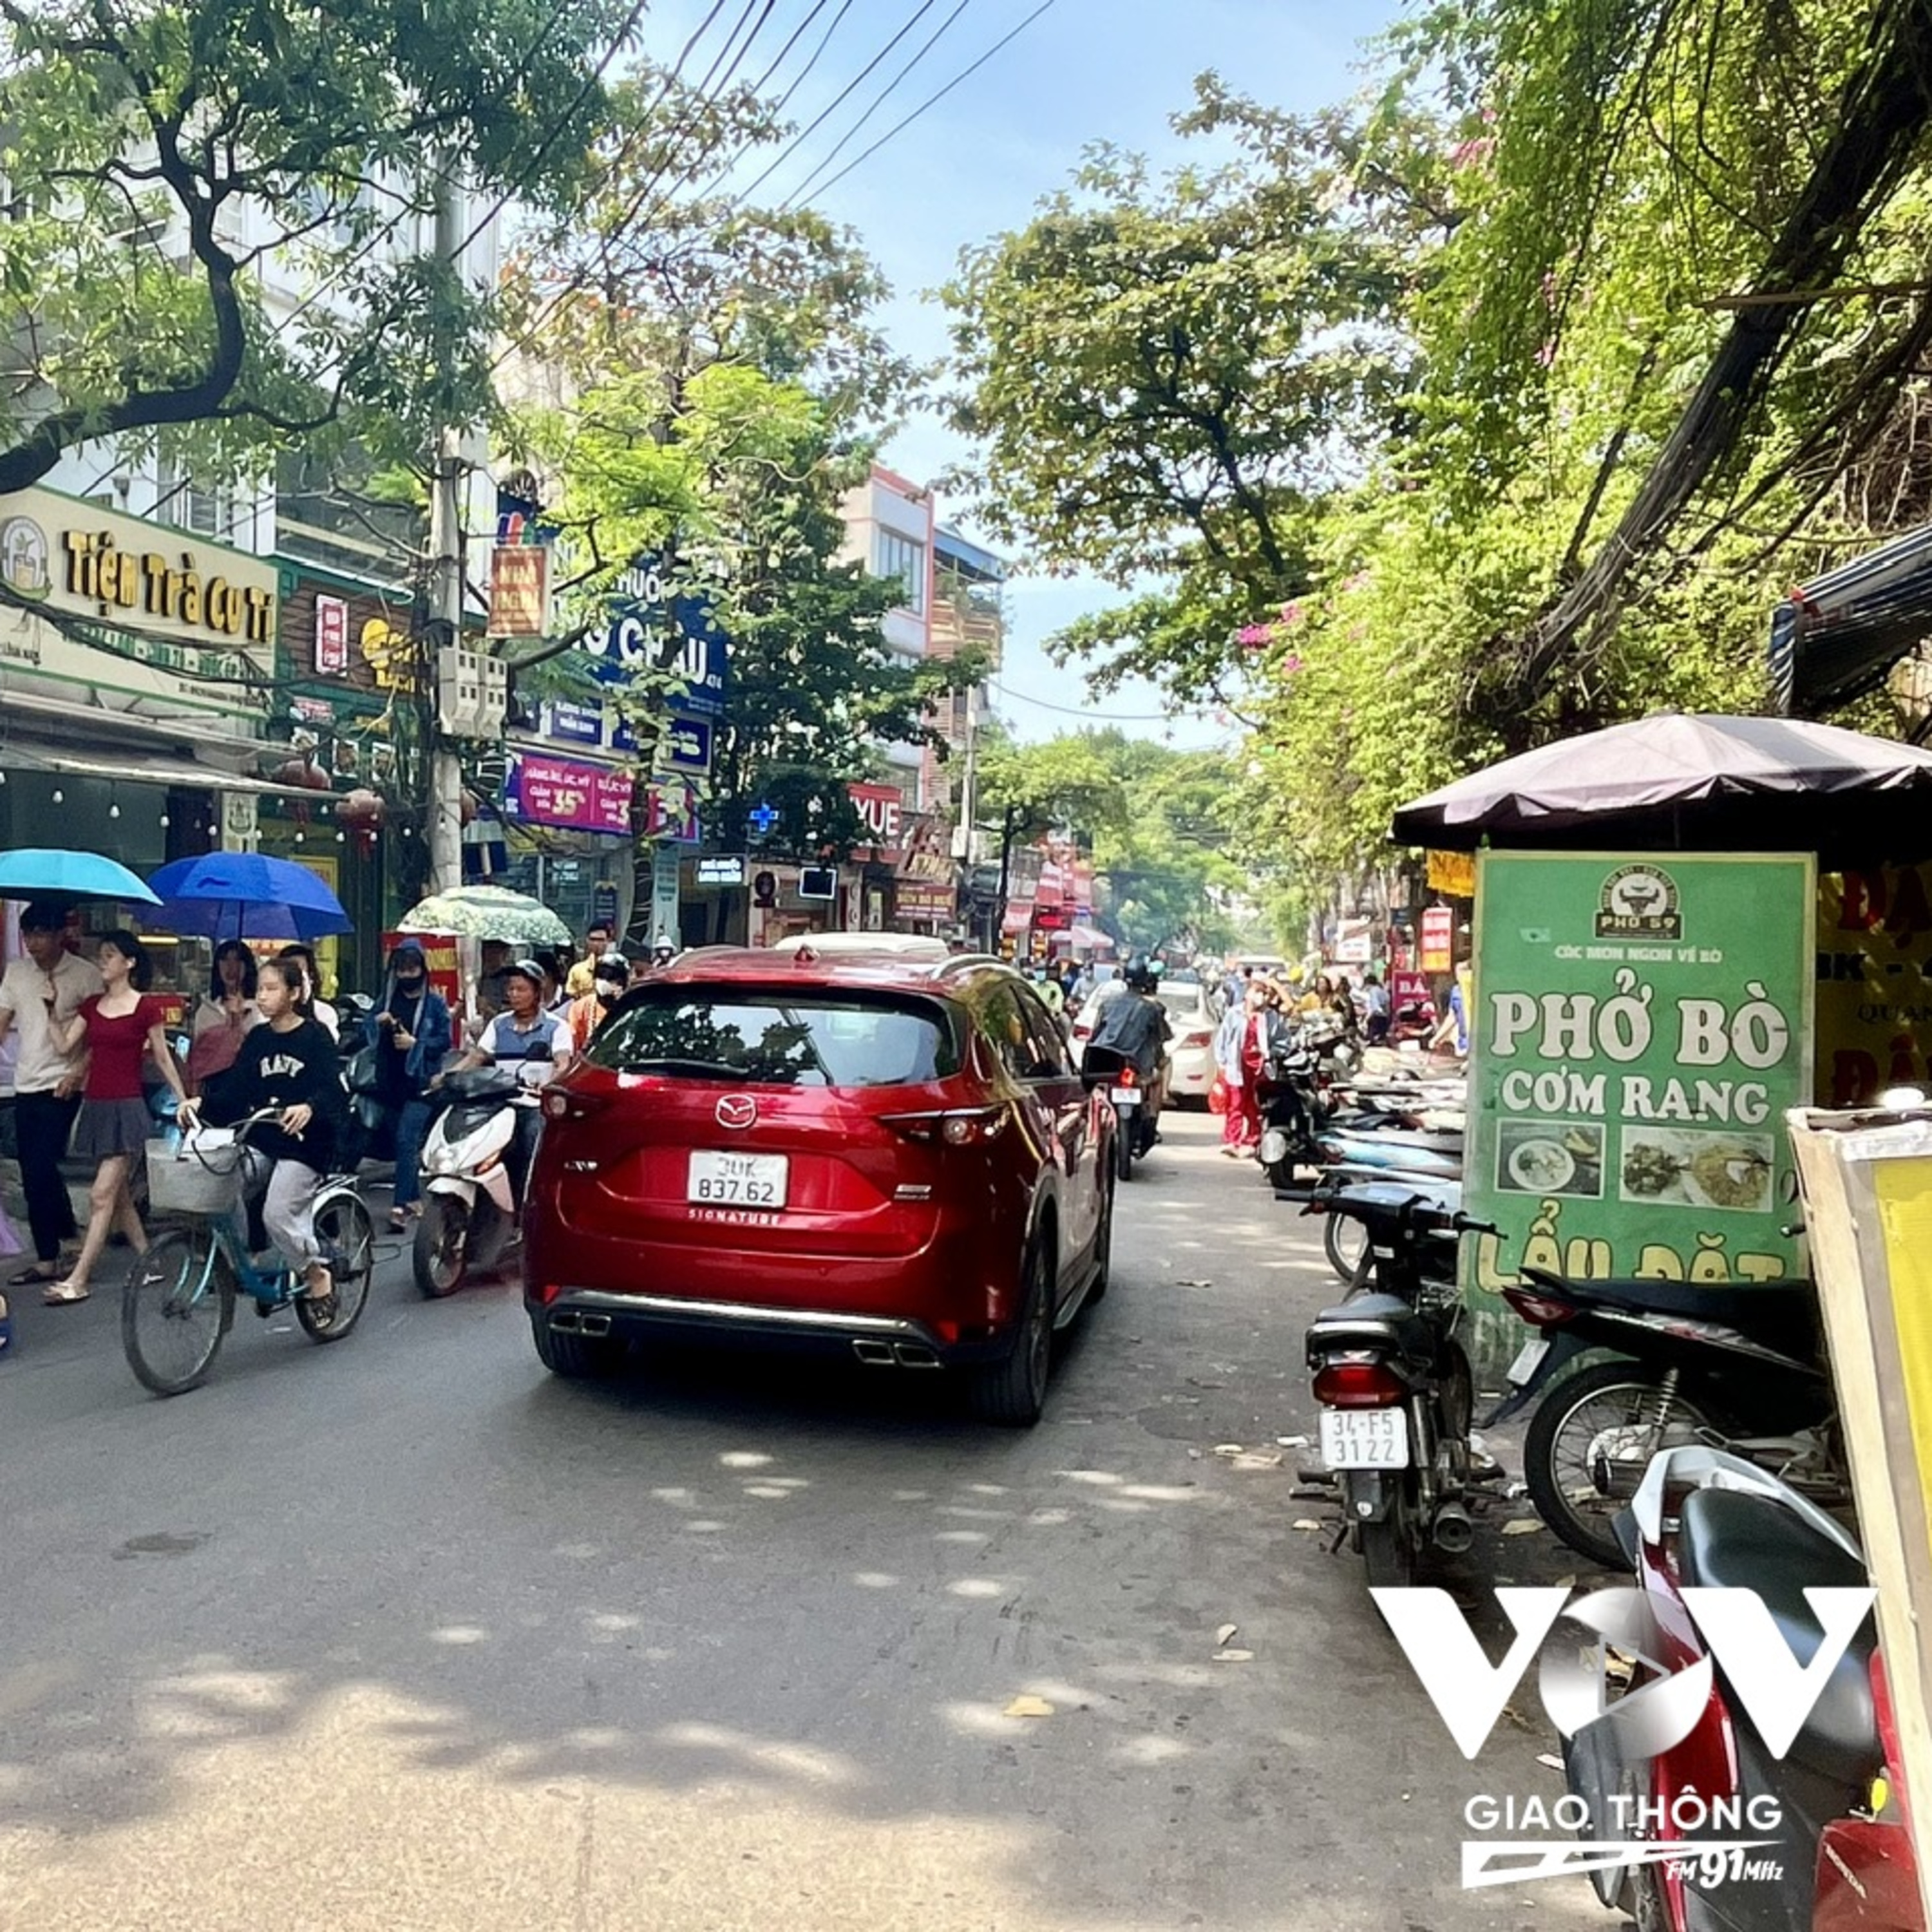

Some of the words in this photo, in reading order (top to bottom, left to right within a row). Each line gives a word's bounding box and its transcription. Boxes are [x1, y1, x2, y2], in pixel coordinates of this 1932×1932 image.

[142, 552, 202, 625] Trà
[205, 576, 243, 634] Cu
[1490, 967, 1654, 1063] PHỞ
[1675, 980, 1790, 1070] BÒ
[1502, 1065, 1607, 1115] CƠM
[1620, 1075, 1770, 1126] RANG
[699, 1179, 775, 1202] 837.62
[688, 1209, 780, 1226] SIGNATURE
[1334, 1438, 1396, 1463] 3122
